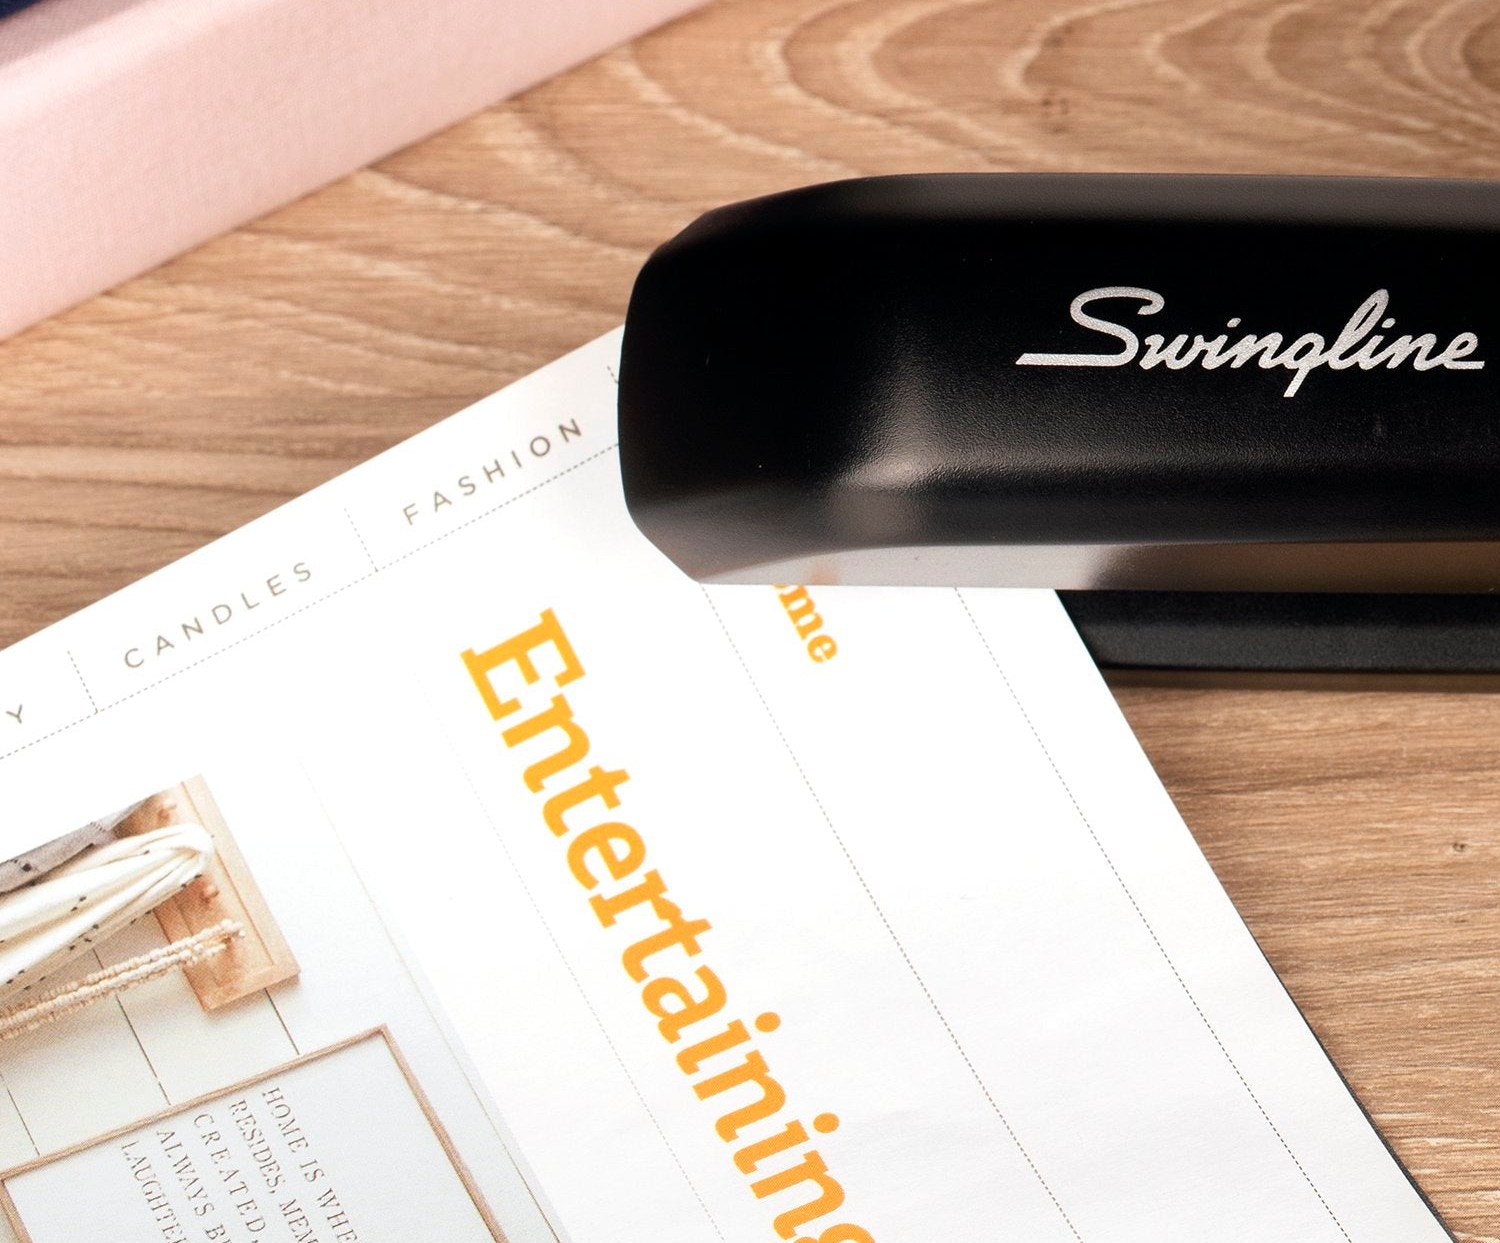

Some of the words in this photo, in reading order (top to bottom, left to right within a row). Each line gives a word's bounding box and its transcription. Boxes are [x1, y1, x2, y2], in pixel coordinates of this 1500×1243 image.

[1015, 286, 1485, 398] Swingline
[124, 561, 314, 669] CANDLES
[402, 418, 582, 526] FASHION
[773, 584, 838, 664] me
[460, 608, 876, 1243] Entertainin
[156, 1129, 214, 1216] ALWAYS
[230, 1099, 286, 1194] RESIDES,
[262, 1087, 309, 1153] HOME
[300, 1159, 325, 1184] IS
